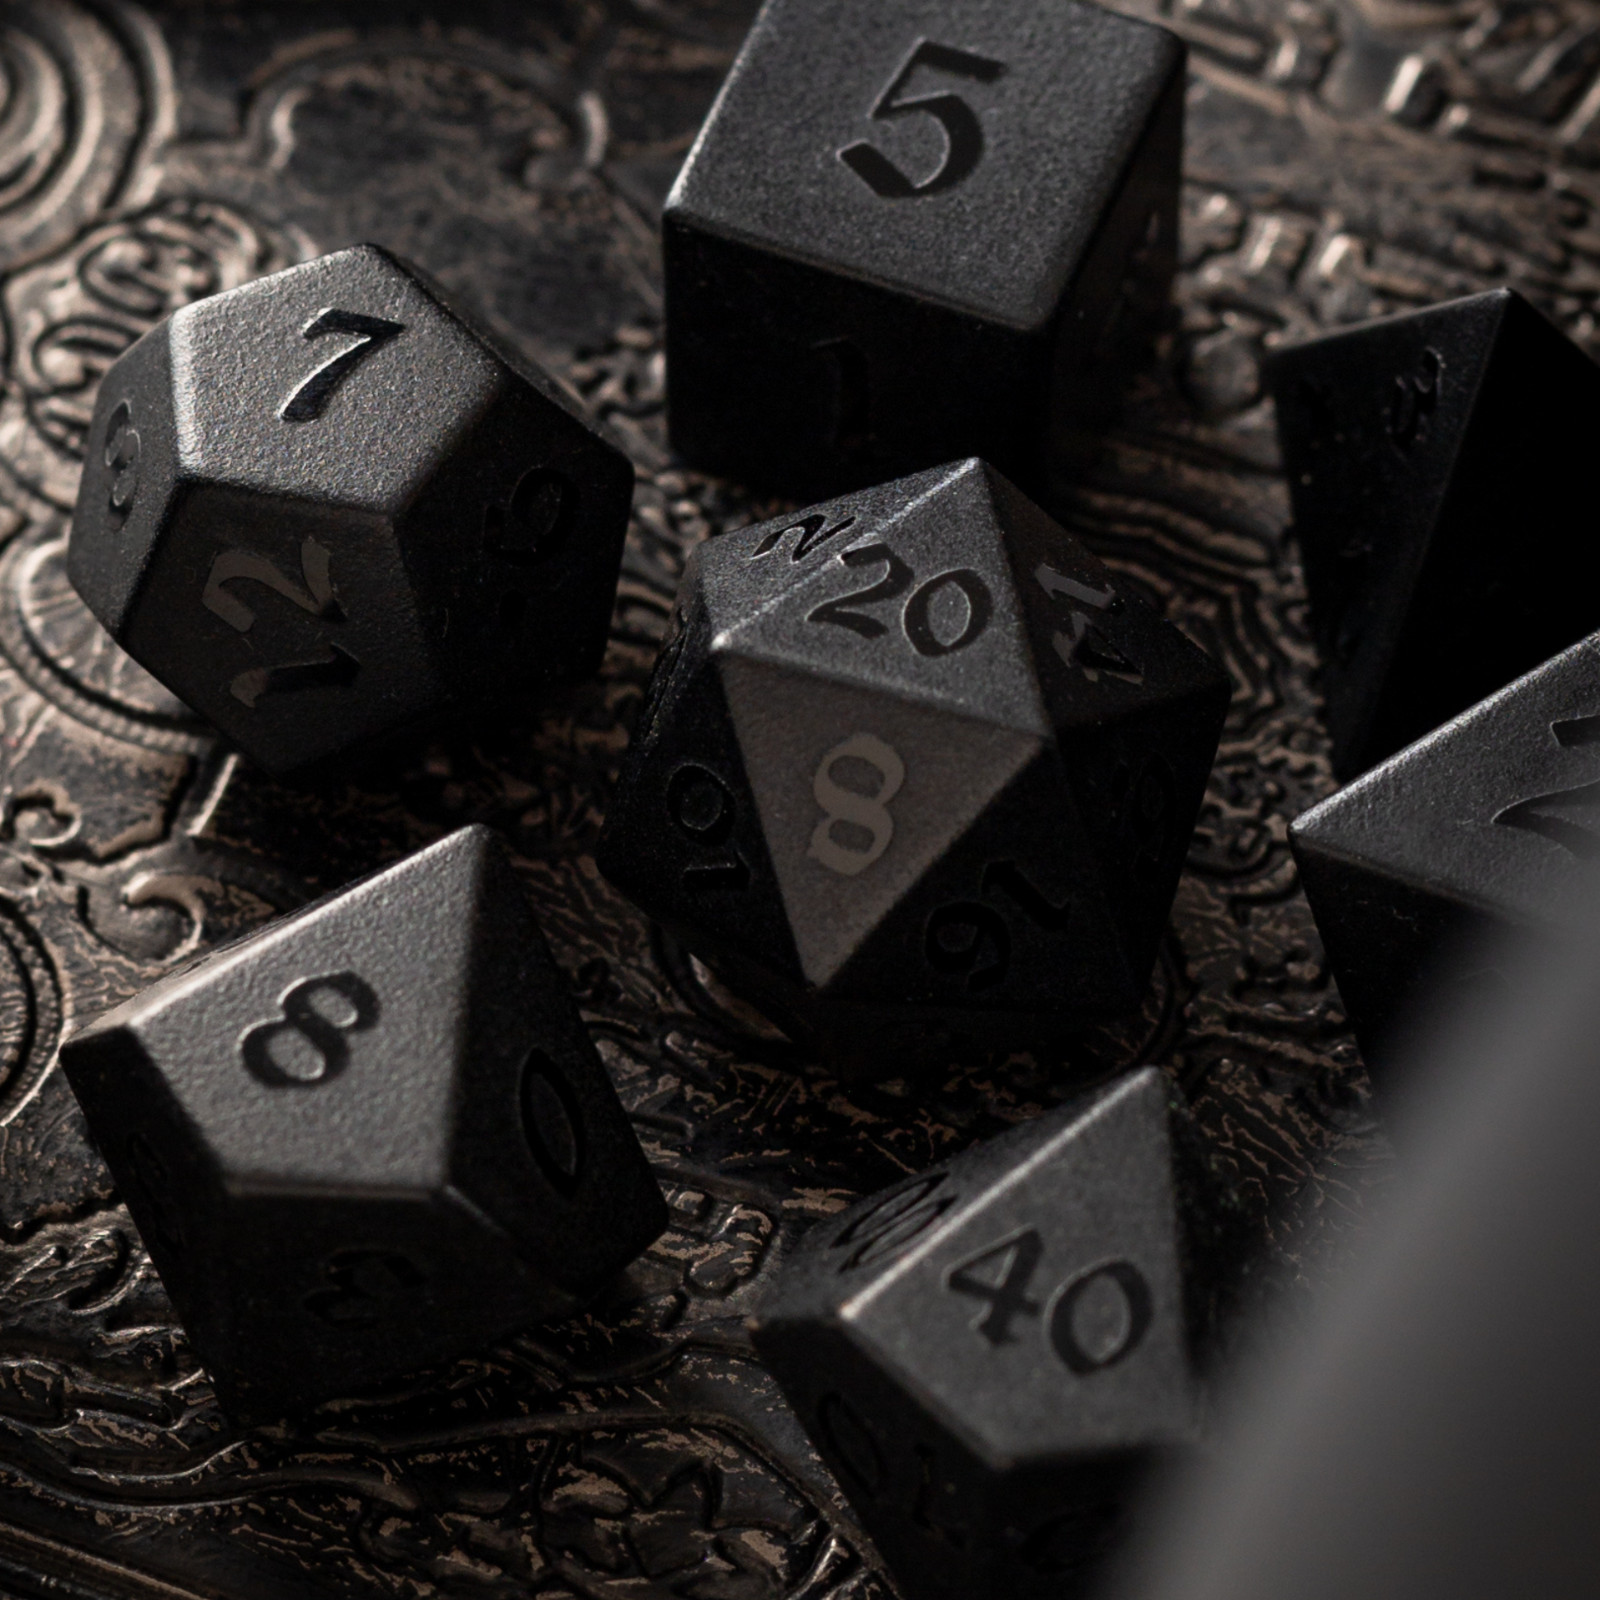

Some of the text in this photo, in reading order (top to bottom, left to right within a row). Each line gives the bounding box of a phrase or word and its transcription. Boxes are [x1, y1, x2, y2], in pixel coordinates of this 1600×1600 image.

[838, 36, 1010, 199] 5
[280, 306, 405, 422] 7
[752, 513, 857, 562] 2
[806, 534, 993, 658] 20
[201, 534, 362, 709] 12
[1033, 562, 1147, 686] 14
[665, 762, 751, 891] 10
[803, 731, 905, 876] 8
[923, 858, 1072, 993] 16
[241, 969, 383, 1089] 8
[519, 1046, 586, 1199] 0
[944, 1223, 1156, 1380] 40
